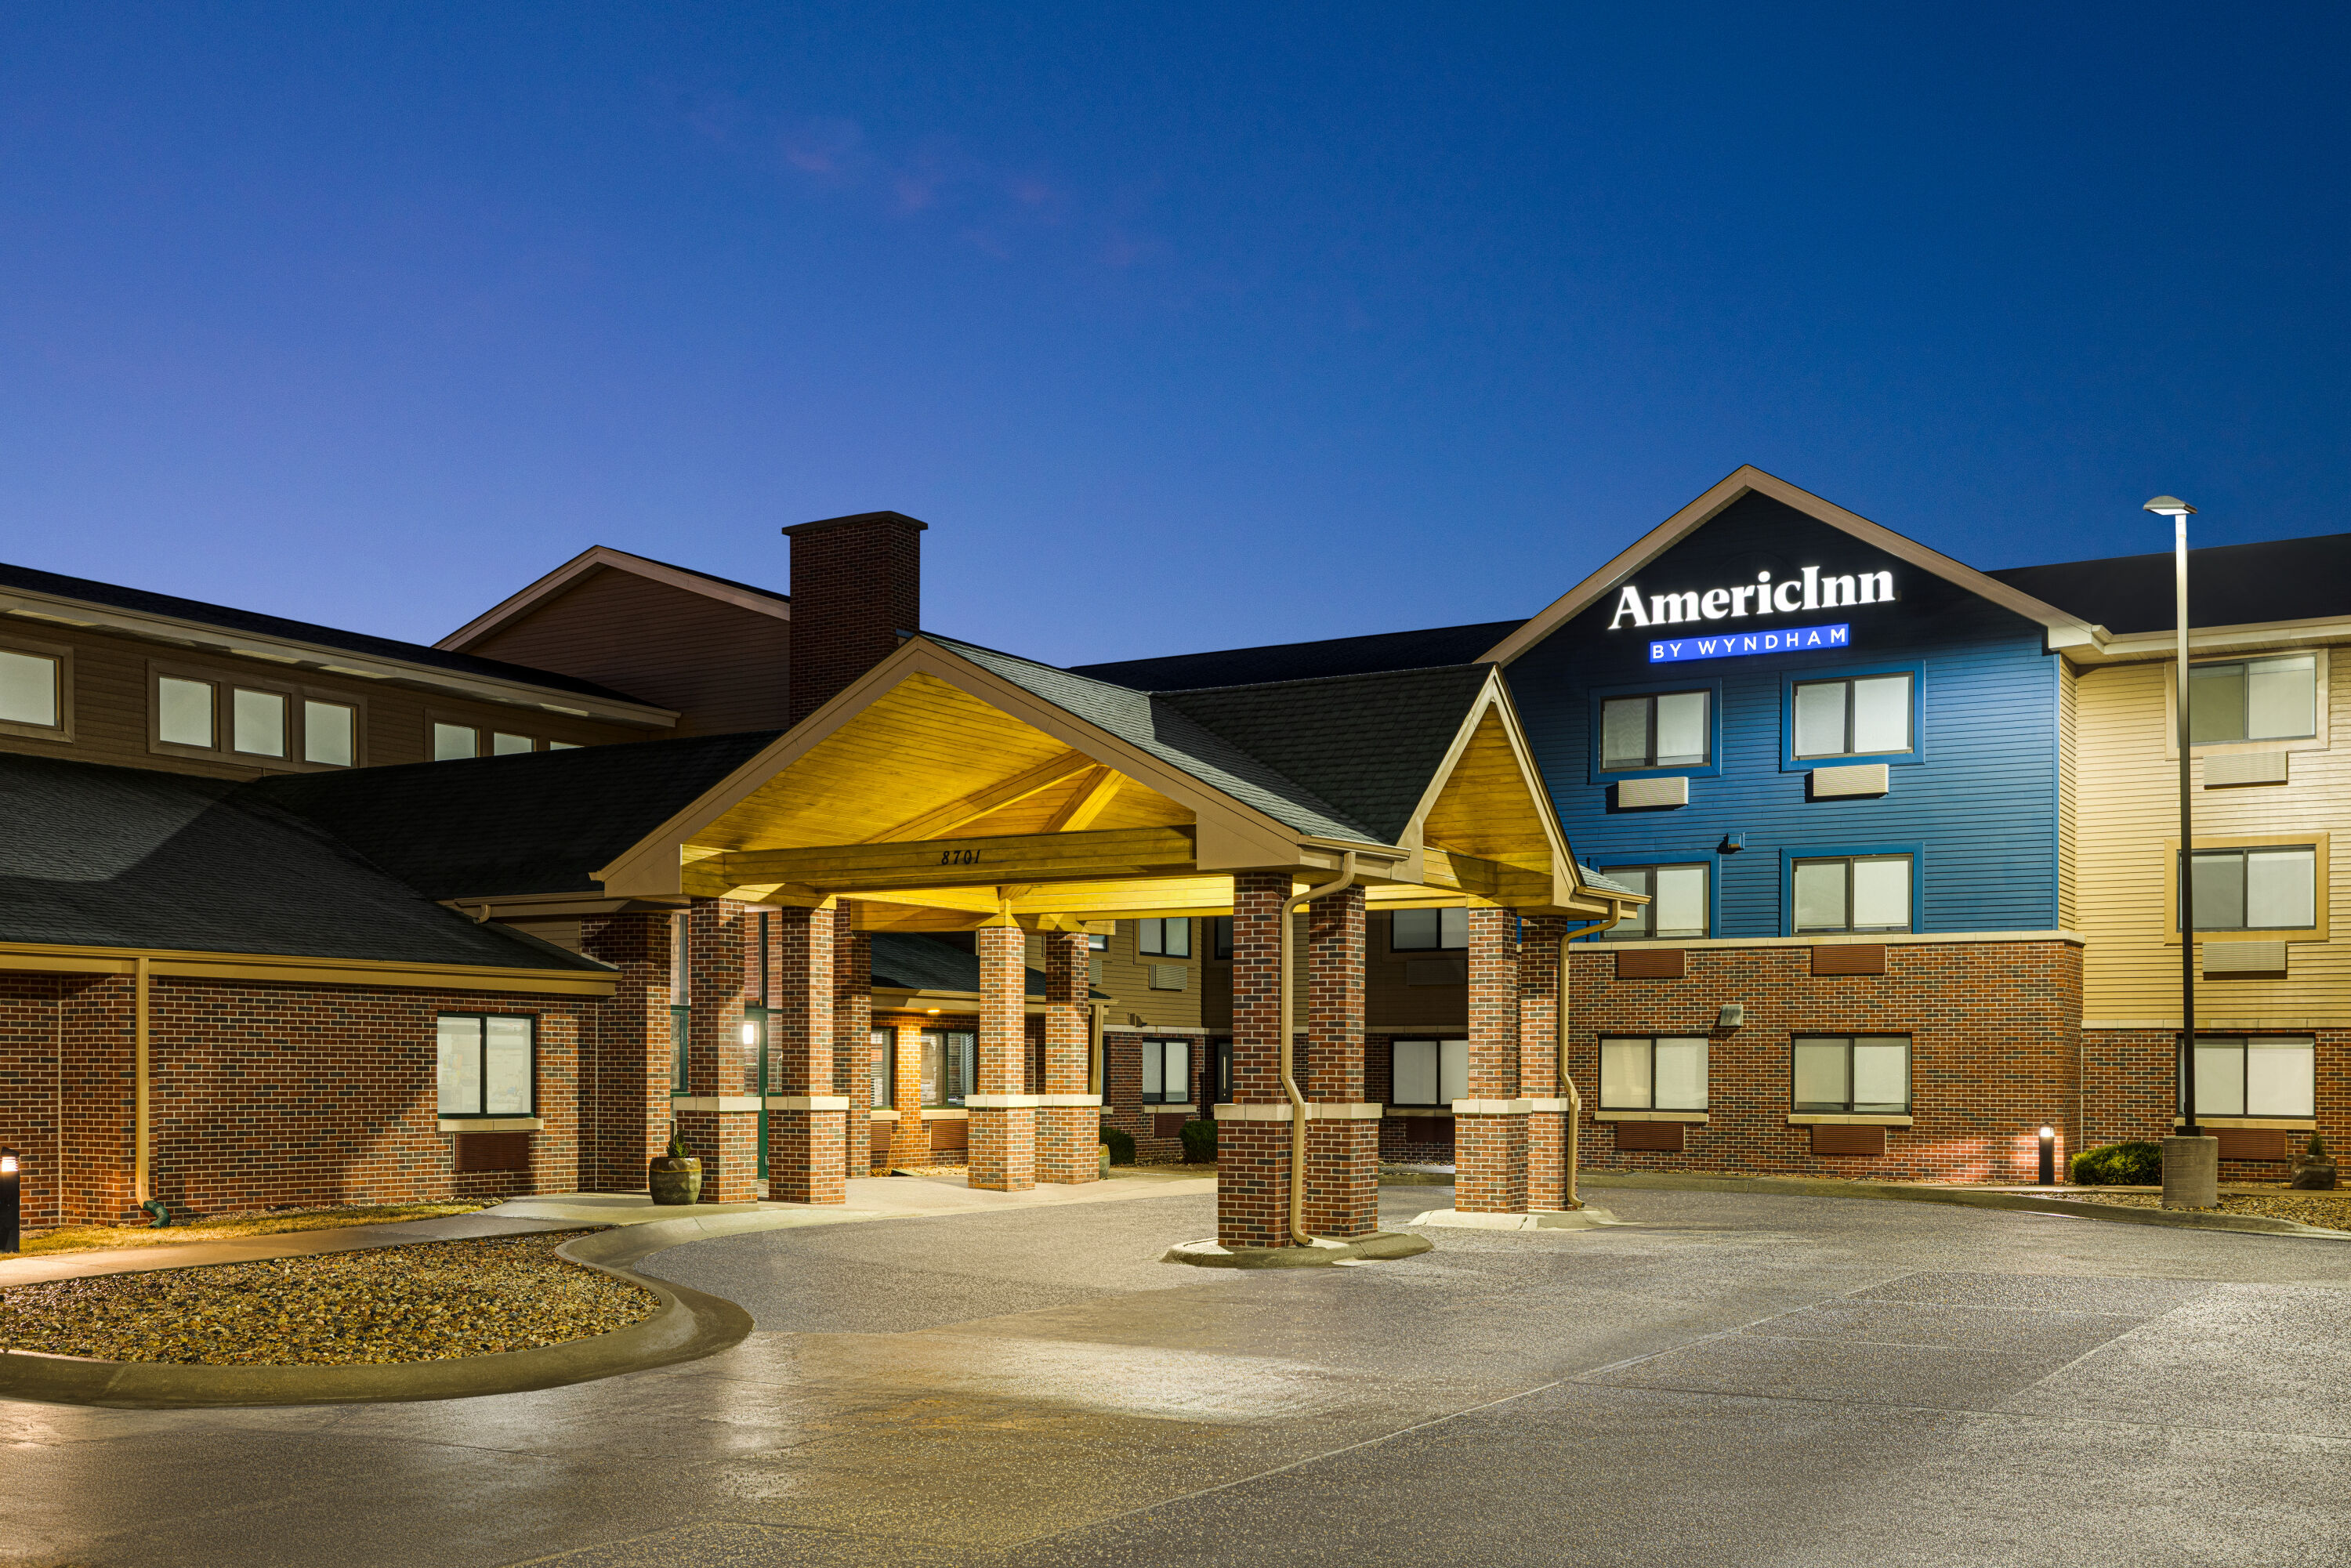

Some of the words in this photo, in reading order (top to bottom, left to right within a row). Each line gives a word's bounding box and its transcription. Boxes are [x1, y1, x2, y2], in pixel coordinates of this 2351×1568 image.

[1607, 566, 1896, 629] AmericInn
[1652, 643, 1683, 659] BY
[1697, 628, 1846, 655] WYNDHAM
[941, 849, 981, 866] 8701
